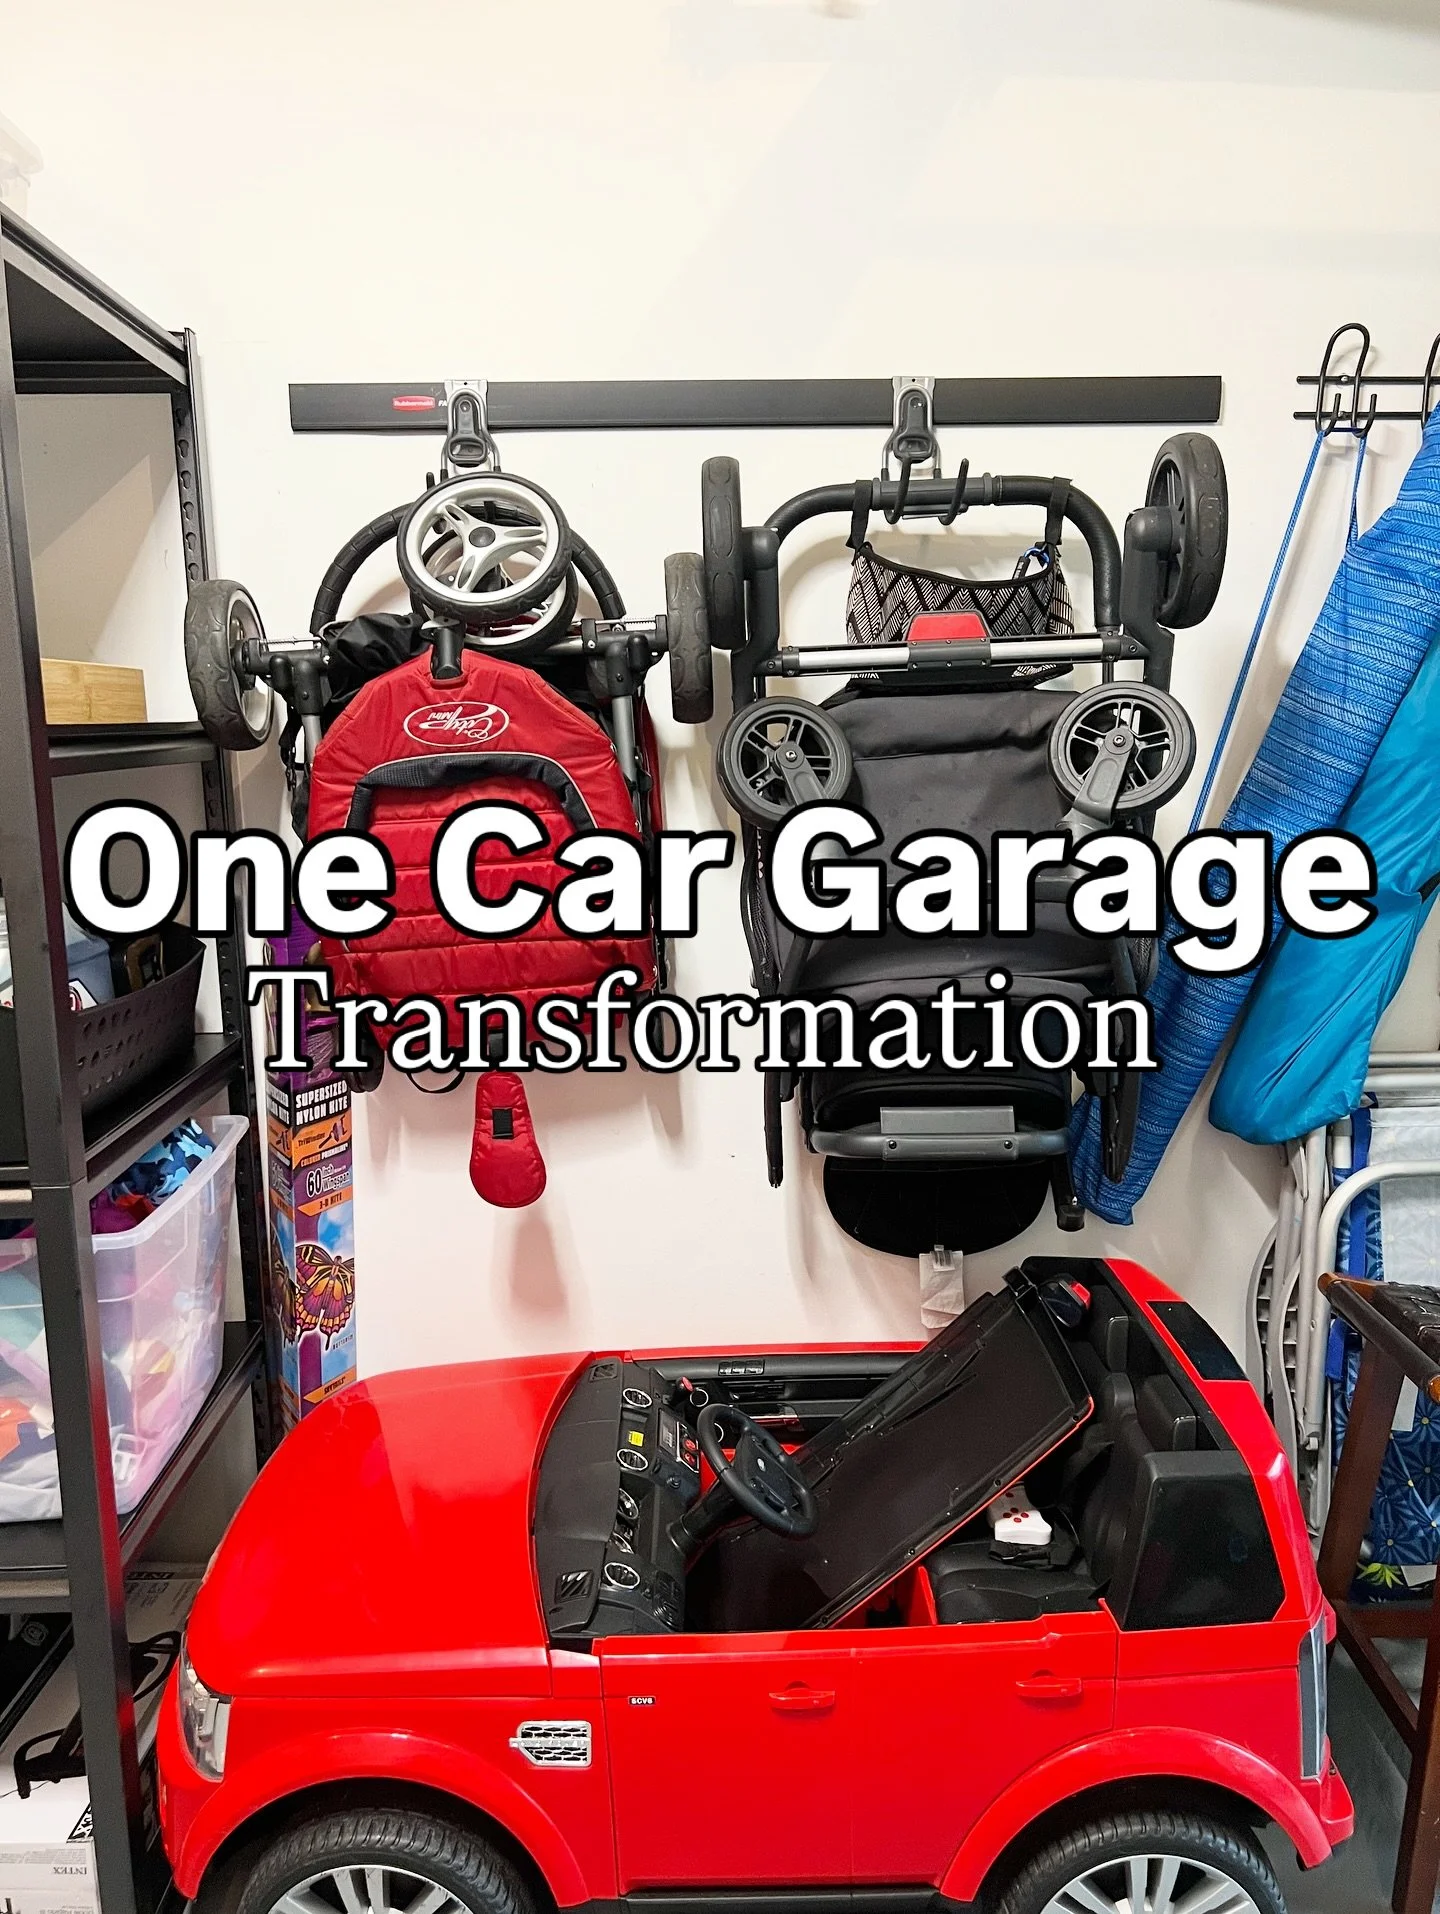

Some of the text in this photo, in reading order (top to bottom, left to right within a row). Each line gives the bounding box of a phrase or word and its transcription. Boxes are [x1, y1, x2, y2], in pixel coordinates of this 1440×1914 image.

[418, 705, 494, 739] City
[295, 1080, 348, 1109] SUPERSIZED
[296, 1102, 327, 1126] NYLON
[328, 1095, 348, 1115] KITE
[306, 1167, 322, 1198] 60
[330, 1191, 342, 1206] KITE
[53, 1866, 88, 1875] INTEX
